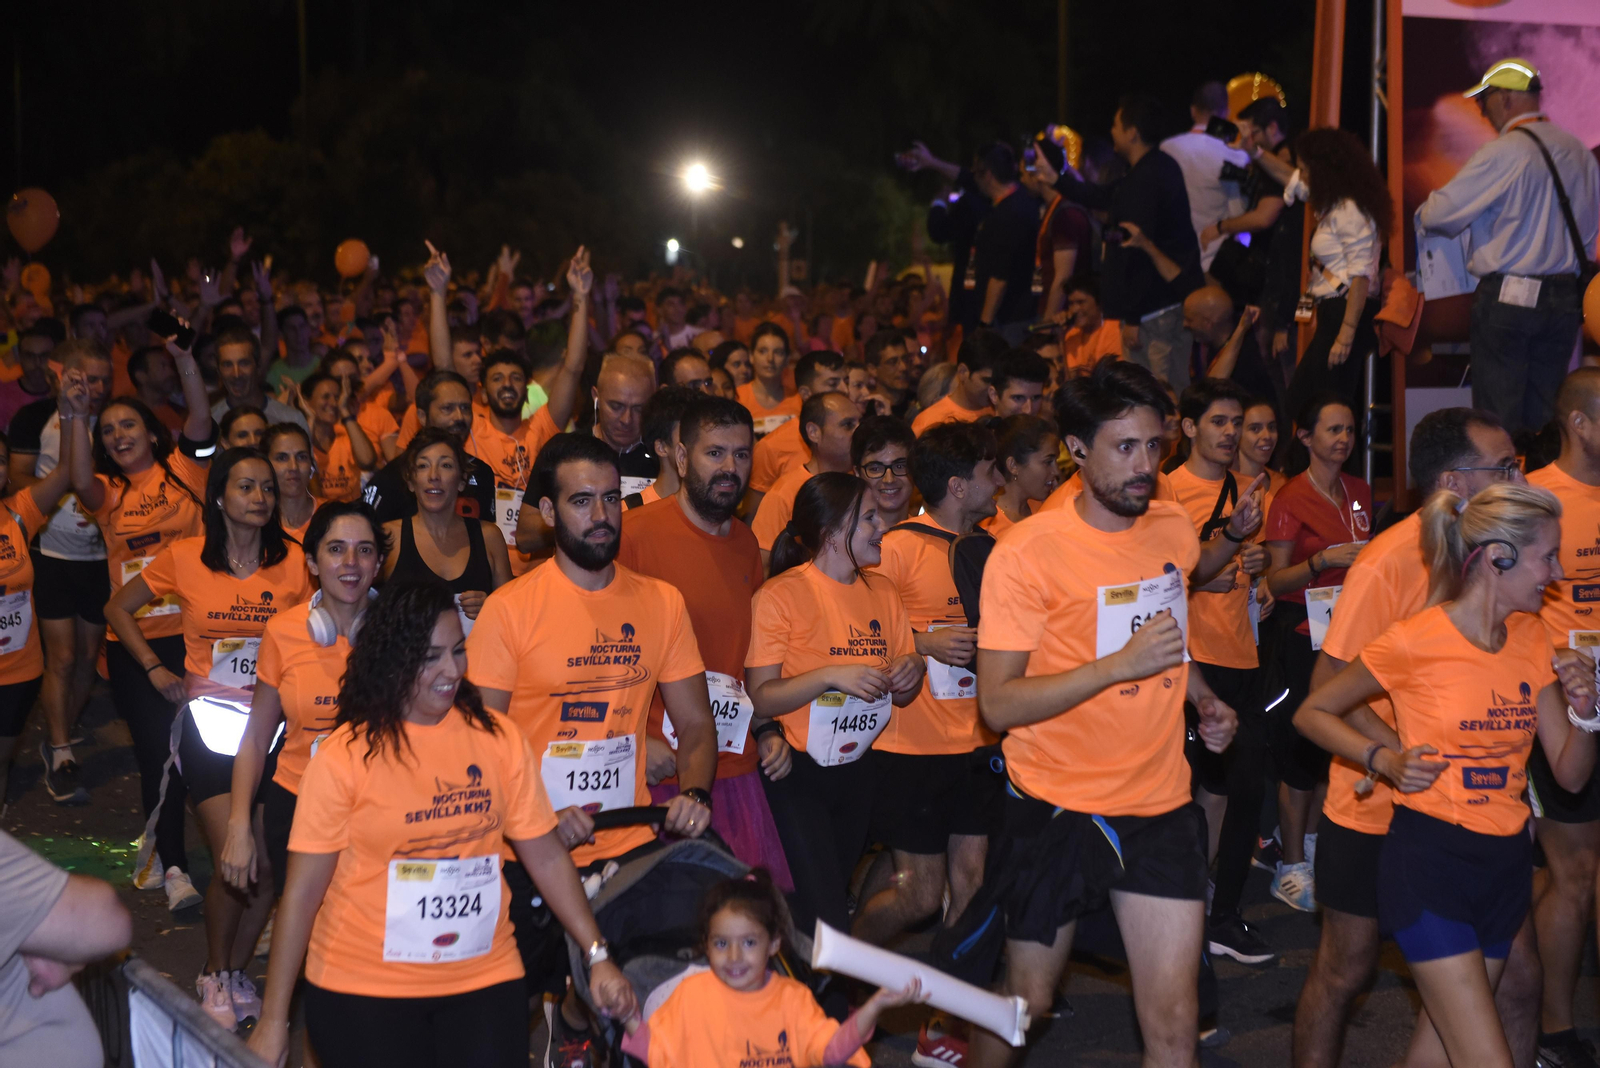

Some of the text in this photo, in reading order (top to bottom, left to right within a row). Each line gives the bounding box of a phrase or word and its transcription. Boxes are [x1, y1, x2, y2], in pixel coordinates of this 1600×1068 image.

[230, 605, 278, 614] NOCTURNA
[207, 611, 251, 622] SEVILLA
[848, 638, 887, 647] NOCTURNA
[590, 644, 641, 654] NOCTURNA
[829, 646, 869, 656] SEVILLA
[567, 656, 611, 667] SEVILLA
[831, 713, 878, 735] 14485
[1459, 720, 1511, 731] SEVILLA
[566, 767, 620, 791] 13321
[433, 788, 491, 806] NOCTURNA
[405, 805, 462, 824] SEVILLA
[417, 891, 482, 920] 13324
